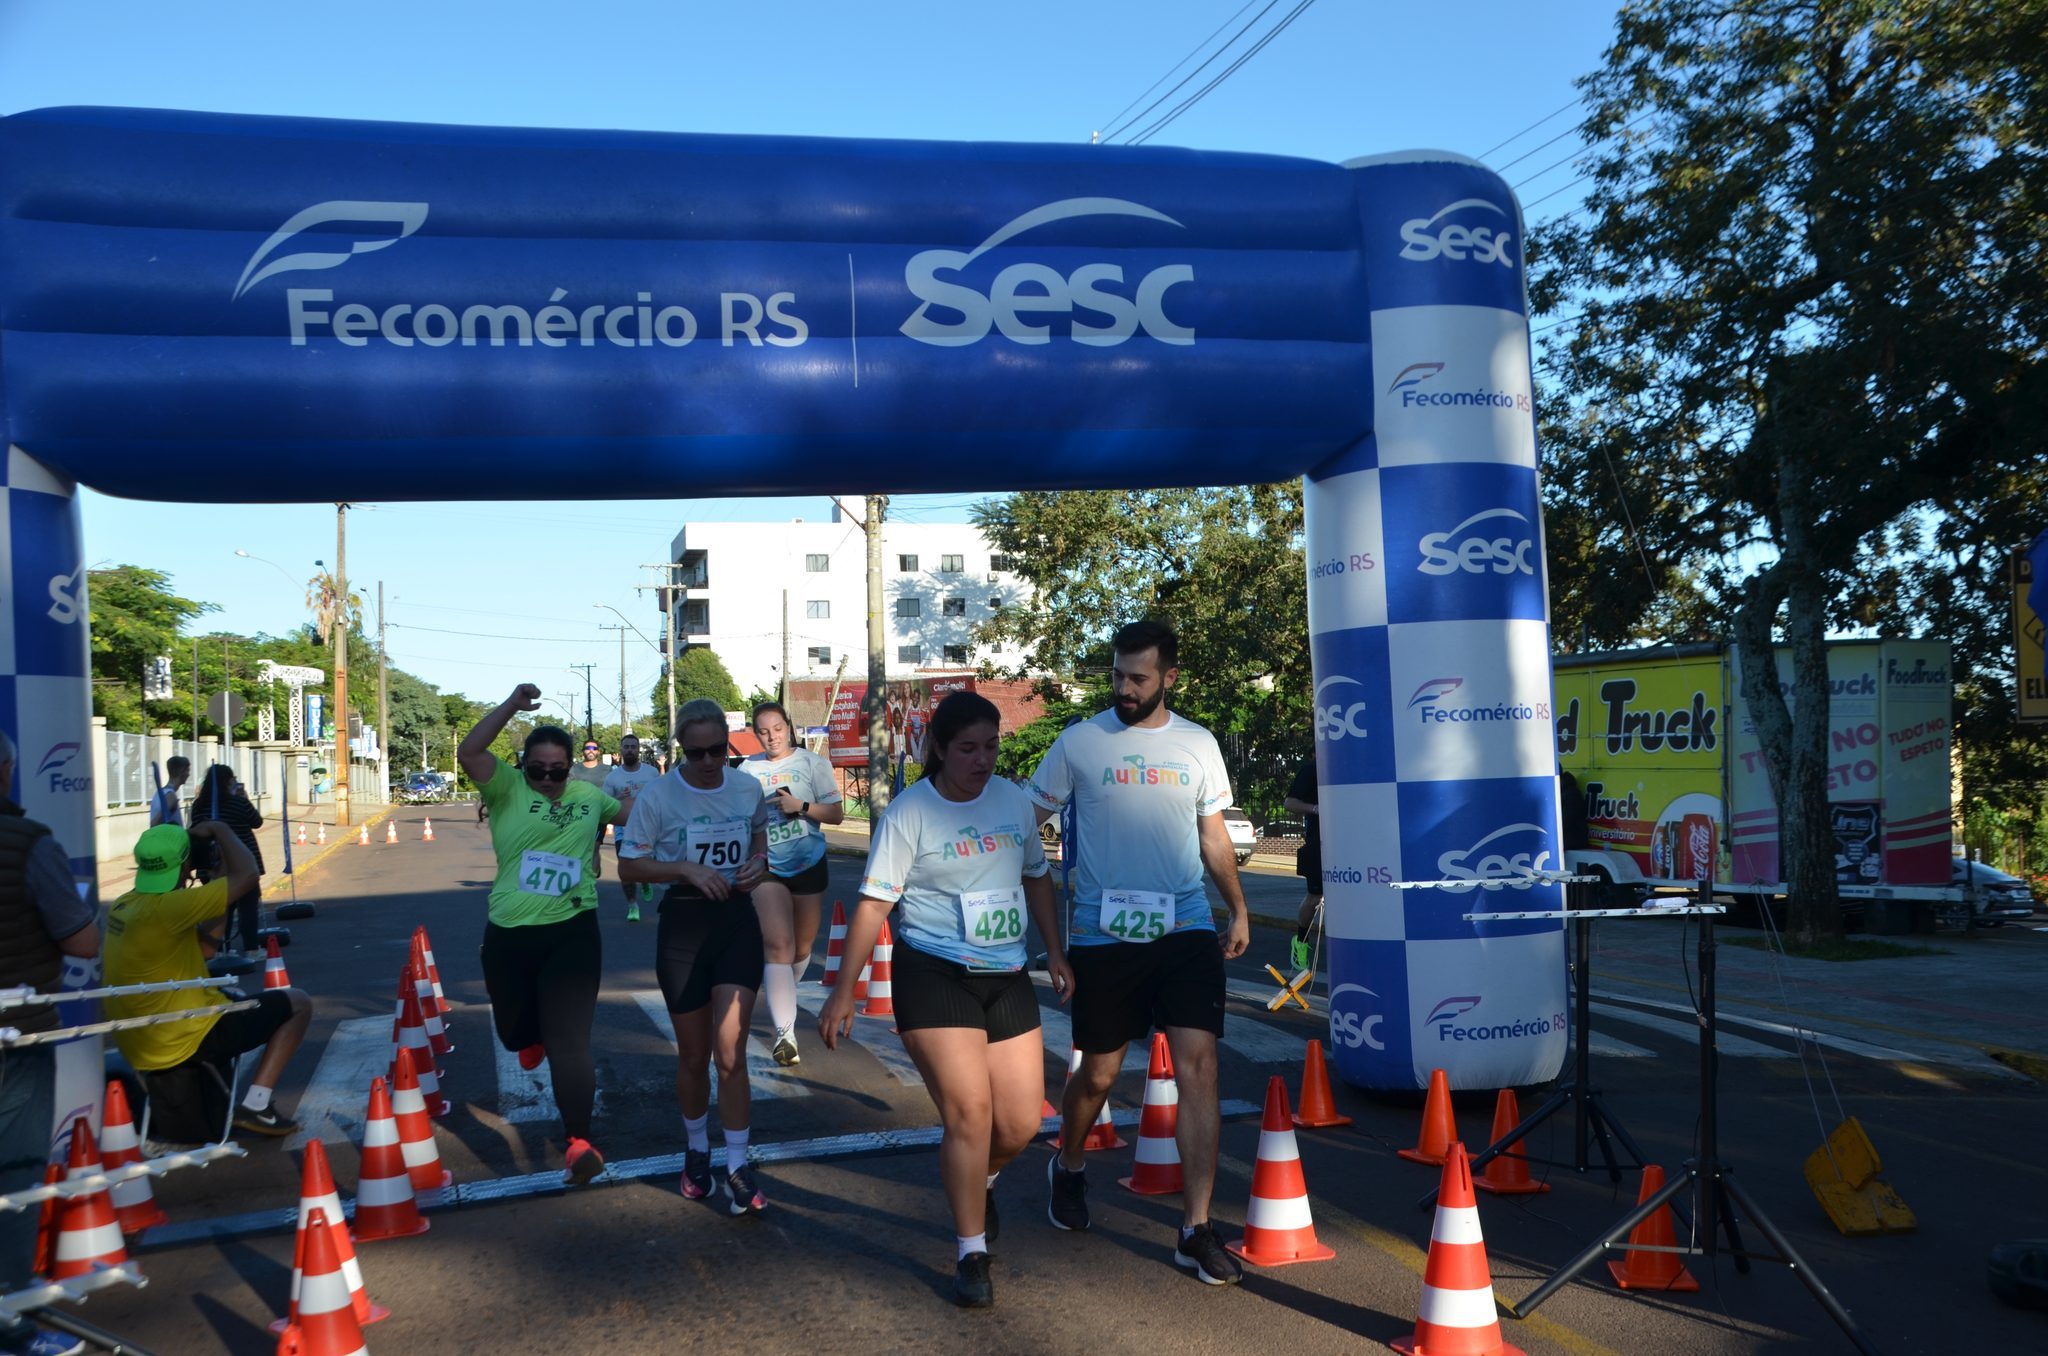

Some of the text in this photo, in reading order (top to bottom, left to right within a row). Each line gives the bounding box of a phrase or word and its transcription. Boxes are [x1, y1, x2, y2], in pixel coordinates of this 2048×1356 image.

[1399, 218, 1514, 268] Sesc
[899, 249, 1196, 347] Sesc
[286, 287, 809, 348] Fecomércio RS
[1402, 388, 1531, 413] Fecomércio RS
[1350, 553, 1375, 576] RS
[1417, 532, 1534, 576] Sesc
[1316, 702, 1368, 742] esc
[1421, 702, 1550, 723] Fecomércio RS
[1601, 680, 1716, 754] Truck
[1832, 722, 1880, 752] NO
[1900, 737, 1944, 762] ESPETO
[1102, 767, 1190, 786] Autismo
[768, 818, 803, 843] 554
[695, 840, 741, 866] 750
[943, 832, 1023, 861] Autismo
[526, 867, 571, 894] 470
[1367, 866, 1393, 884] RS
[975, 907, 1022, 941] 428
[1109, 909, 1165, 940] 425
[1331, 1012, 1385, 1050] esc
[1439, 1012, 1566, 1041] Fecomércio RS
